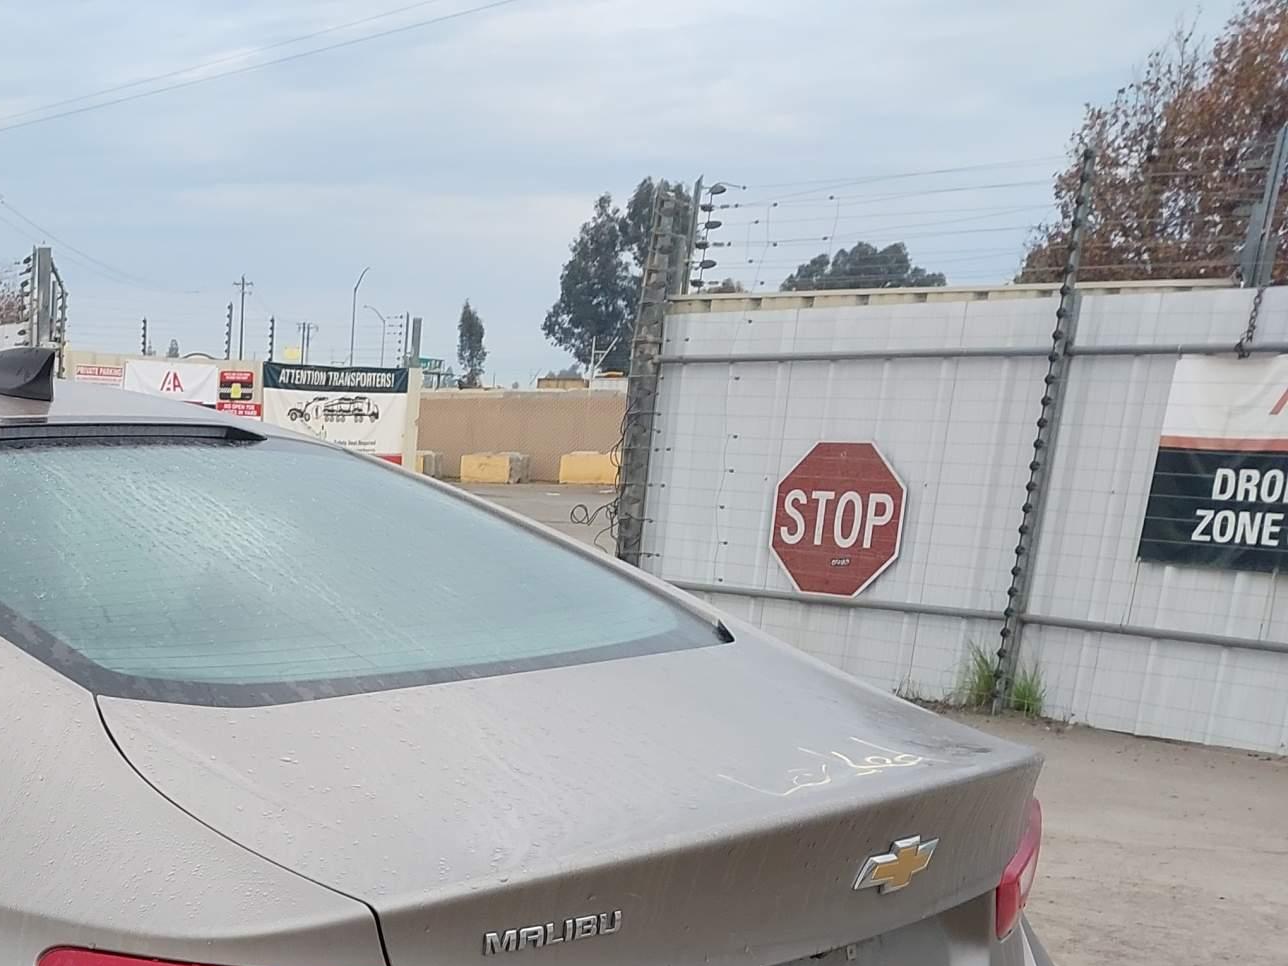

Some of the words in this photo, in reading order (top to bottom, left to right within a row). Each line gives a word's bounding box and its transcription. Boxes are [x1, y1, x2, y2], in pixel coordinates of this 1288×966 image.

[279, 368, 327, 386] ATTENTION
[327, 371, 394, 388] TRANSPORTERS!
[780, 488, 895, 549] STOP
[1191, 509, 1284, 547] ZONE
[483, 910, 622, 955] MALIBU
